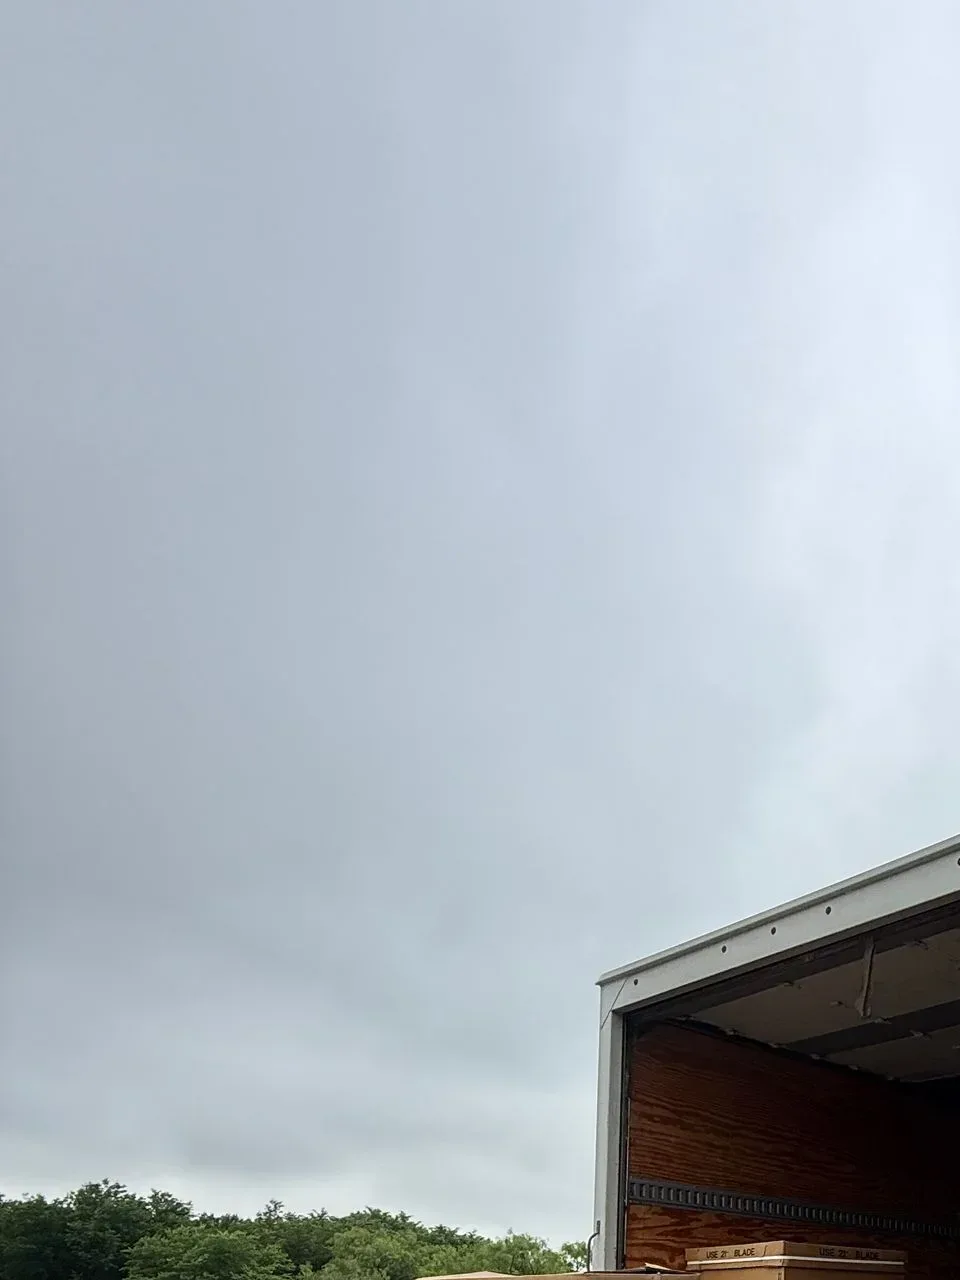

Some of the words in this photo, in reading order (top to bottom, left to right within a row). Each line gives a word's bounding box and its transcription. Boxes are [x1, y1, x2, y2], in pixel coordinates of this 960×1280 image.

[706, 1249, 718, 1259] USE
[734, 1247, 756, 1257] BLADE
[819, 1248, 835, 1257] USE
[855, 1250, 881, 1260] BLADE
